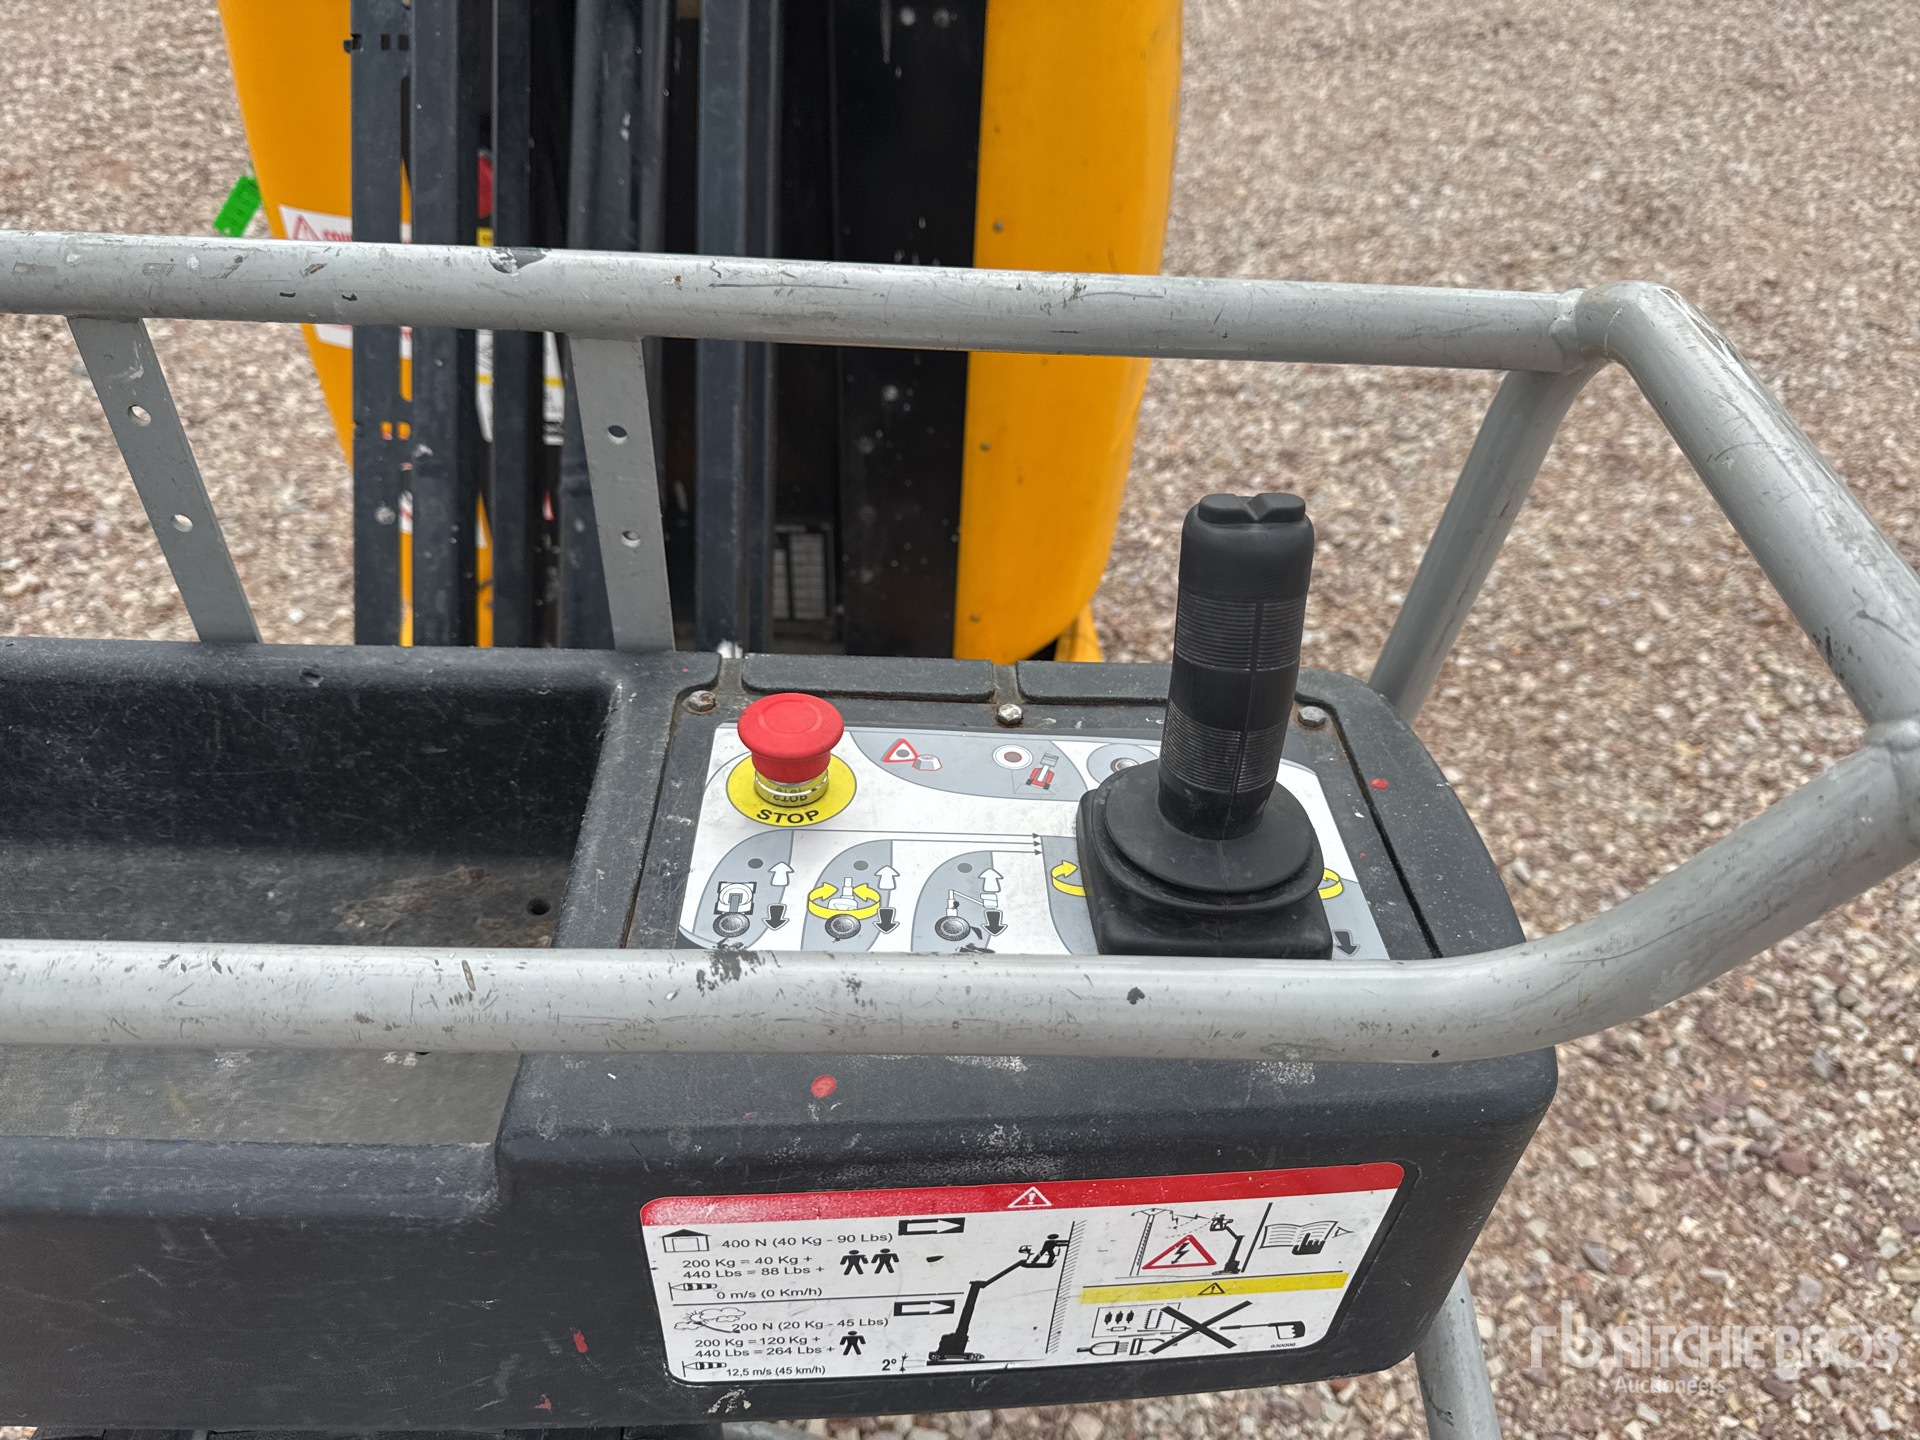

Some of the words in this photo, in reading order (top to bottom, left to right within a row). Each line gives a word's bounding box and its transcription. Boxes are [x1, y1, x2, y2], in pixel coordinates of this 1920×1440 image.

[756, 809, 820, 824] STOP
[721, 1239, 750, 1249] 400
[755, 1238, 767, 1247] N
[772, 1237, 796, 1249] (40
[802, 1236, 822, 1246] Kg
[837, 1234, 856, 1243] 90
[861, 1233, 893, 1243] Lbs)
[682, 1259, 710, 1269] 200
[715, 1258, 735, 1268] Kg
[754, 1256, 774, 1265] 40
[778, 1255, 798, 1266] Kg
[682, 1269, 711, 1279] 440
[715, 1268, 743, 1278] Lbs
[761, 1267, 780, 1276] 88
[784, 1265, 811, 1275] Lbs
[716, 1291, 726, 1300] 0
[730, 1289, 757, 1299] m/s
[761, 1288, 776, 1299] (0
[779, 1287, 823, 1298] Km/h)
[731, 1322, 759, 1332] 200
[762, 1322, 773, 1331] N
[778, 1320, 801, 1332] (20
[804, 1320, 824, 1330] Kg
[836, 1318, 855, 1327] 45
[859, 1317, 889, 1327] Lbs)
[694, 1339, 721, 1348] 200
[724, 1338, 744, 1348] Kg
[759, 1336, 786, 1345] 120
[789, 1335, 808, 1345] Kg
[694, 1349, 721, 1358] 440
[724, 1348, 750, 1357] Lbs
[766, 1347, 792, 1355] 264
[797, 1346, 822, 1355] Lbs
[726, 1368, 750, 1378] 12,5
[752, 1367, 773, 1376] m/s
[774, 1366, 793, 1377] (45
[795, 1365, 826, 1375] km/h)
